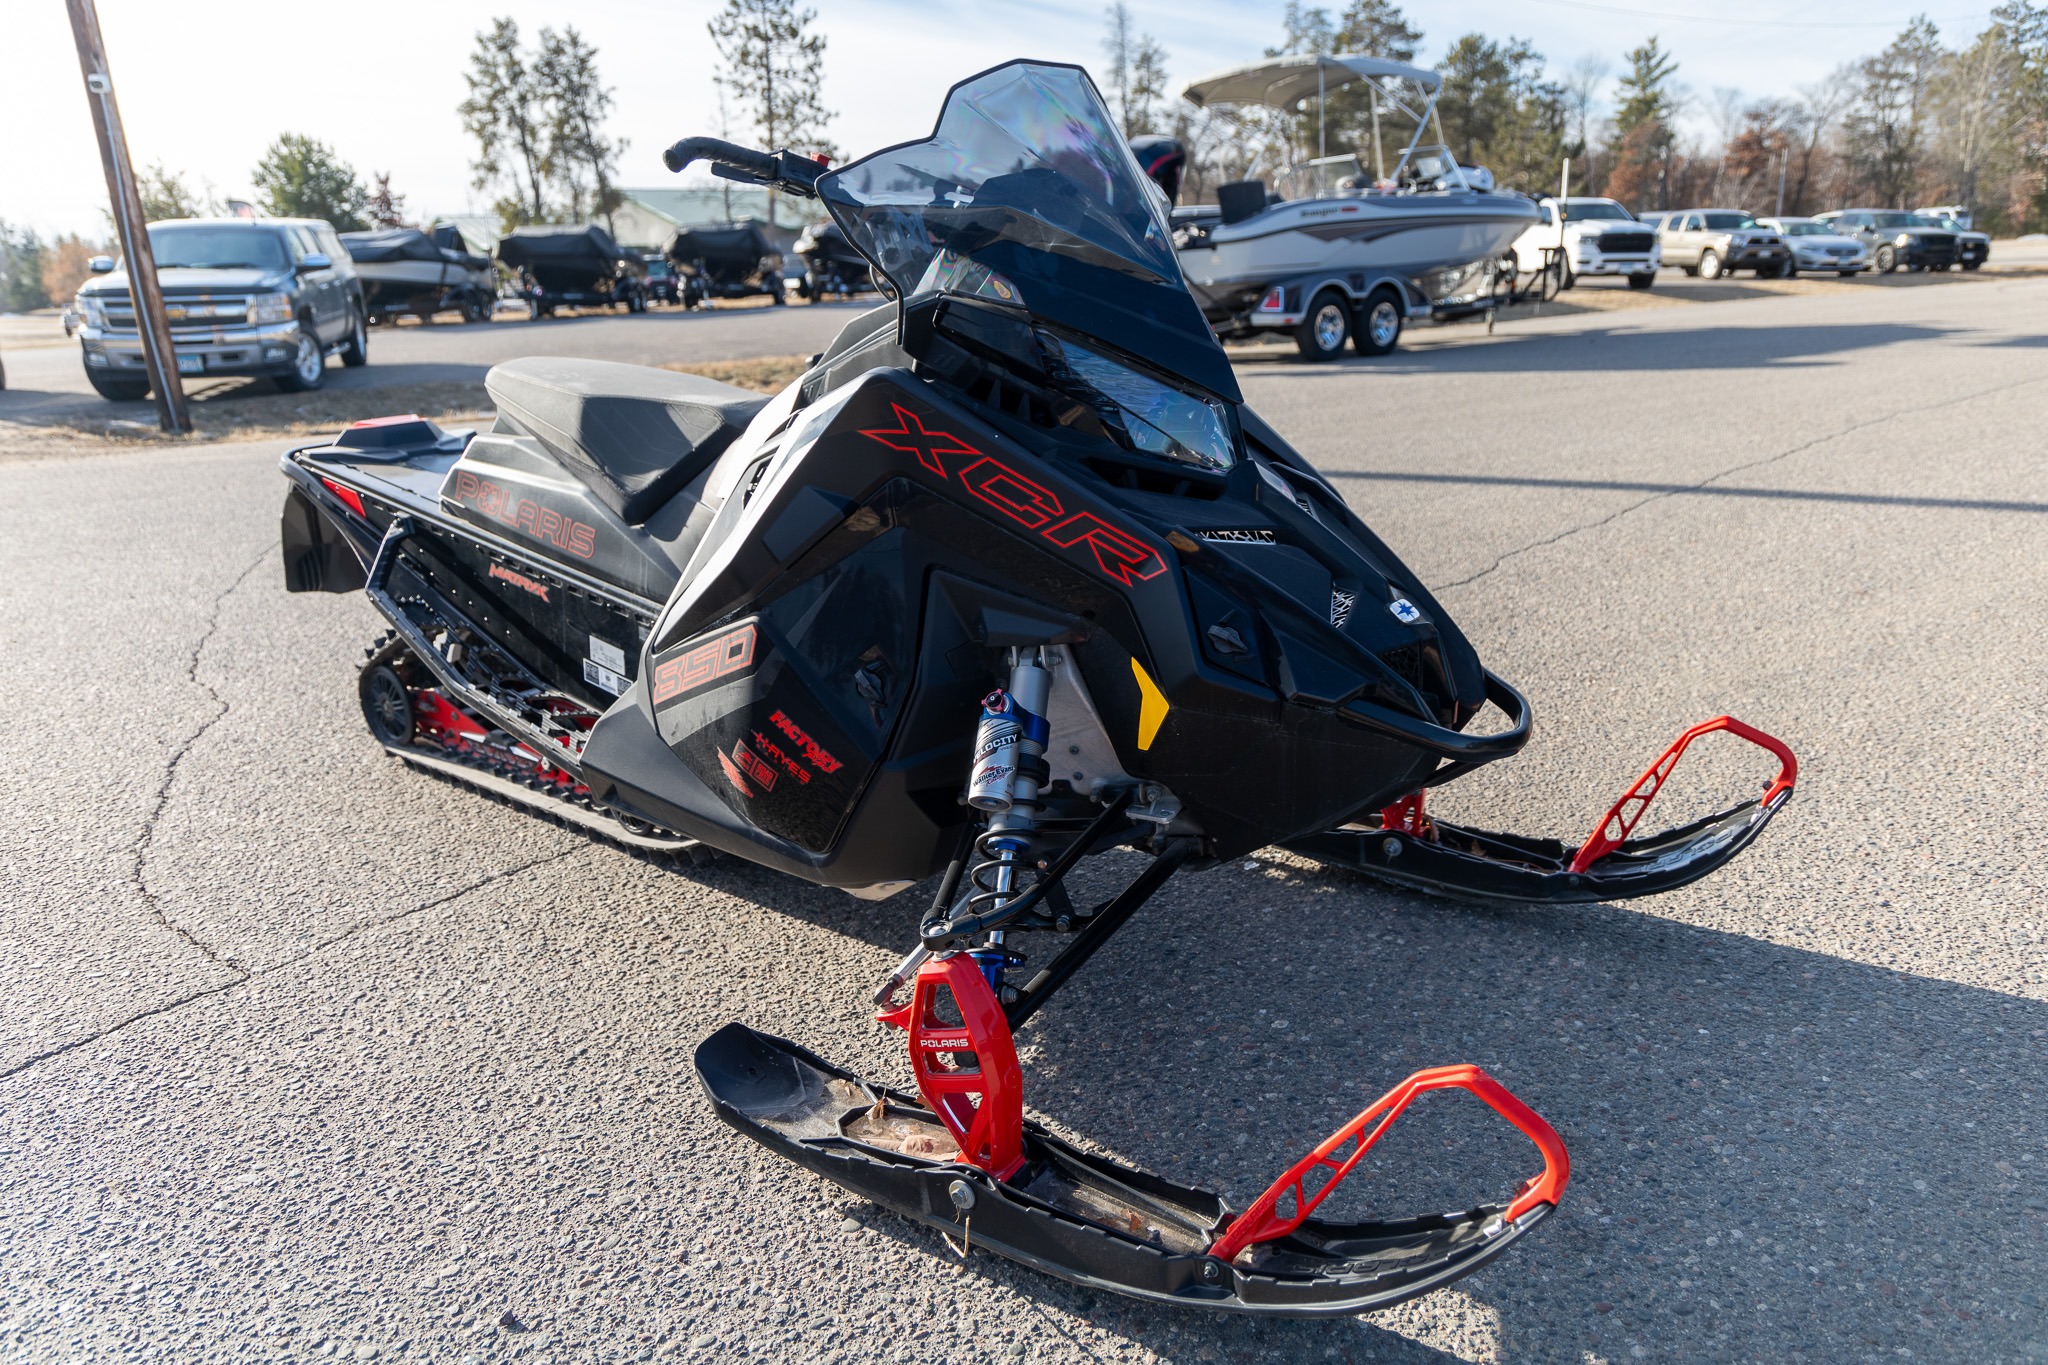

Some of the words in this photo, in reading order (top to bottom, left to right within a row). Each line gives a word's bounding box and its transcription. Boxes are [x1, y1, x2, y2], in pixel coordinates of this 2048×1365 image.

[455, 471, 596, 559] POLARIS
[857, 402, 1168, 587] XCR
[488, 562, 550, 604] MATRYX
[653, 624, 757, 704] 850
[751, 729, 811, 783] HAYES
[769, 710, 844, 772] FACTORY
[920, 1038, 969, 1048] POLARIS
